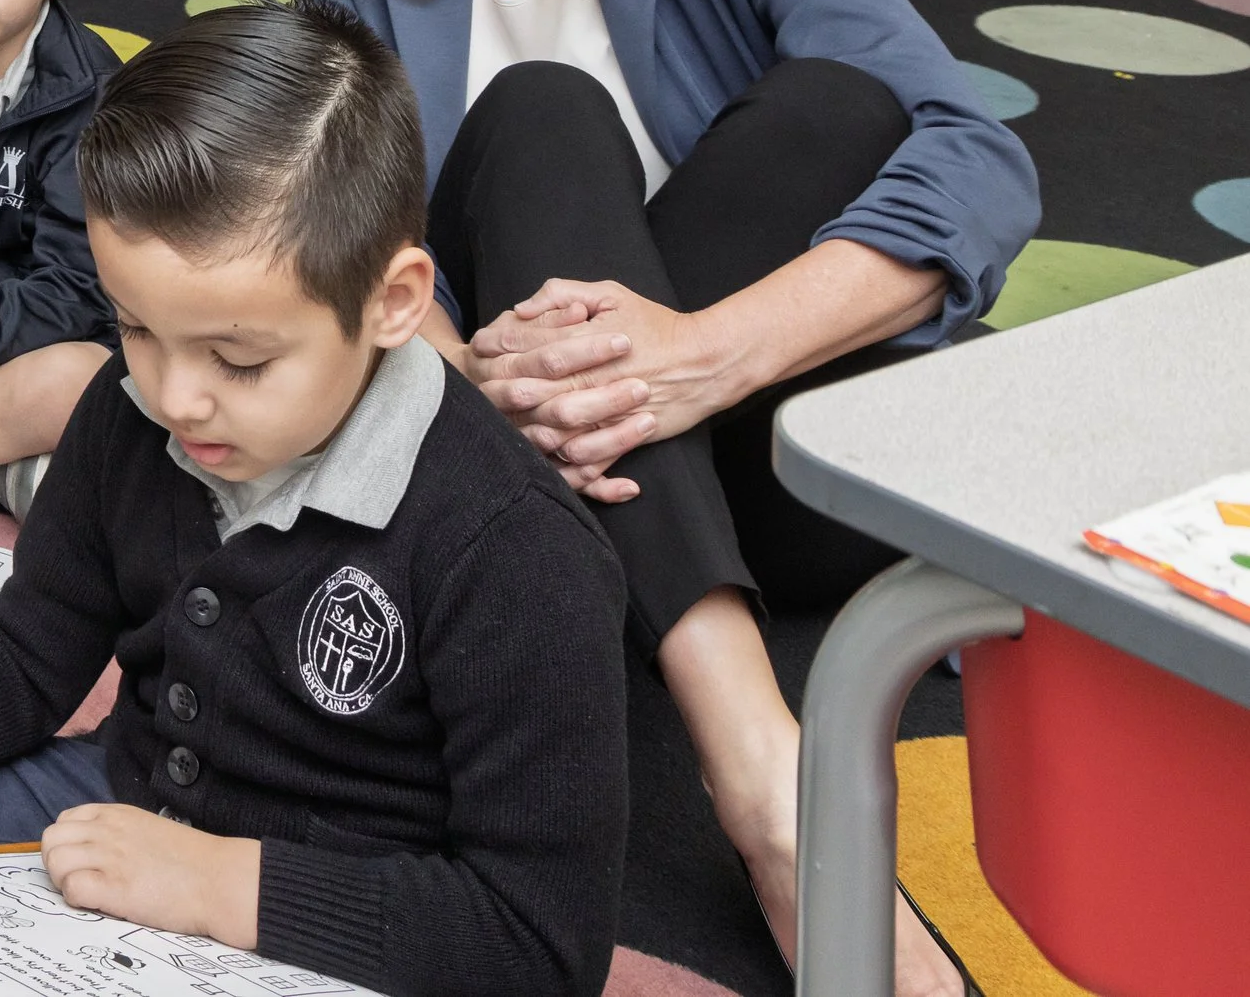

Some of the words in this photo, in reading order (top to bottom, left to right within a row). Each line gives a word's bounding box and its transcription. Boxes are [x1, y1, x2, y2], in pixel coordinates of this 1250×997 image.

[325, 569, 348, 593] SAINT
[347, 570, 372, 590] ANNE
[370, 585, 401, 634] SCHOOL
[330, 604, 376, 640] SAS
[301, 662, 325, 703] SANTA
[326, 698, 350, 713] ANA
[0, 946, 23, 959] like
[21, 944, 52, 961] over
[21, 959, 85, 992] butterfly
[51, 961, 74, 973] fly
[28, 975, 71, 997] yellow
[73, 973, 107, 992] They
